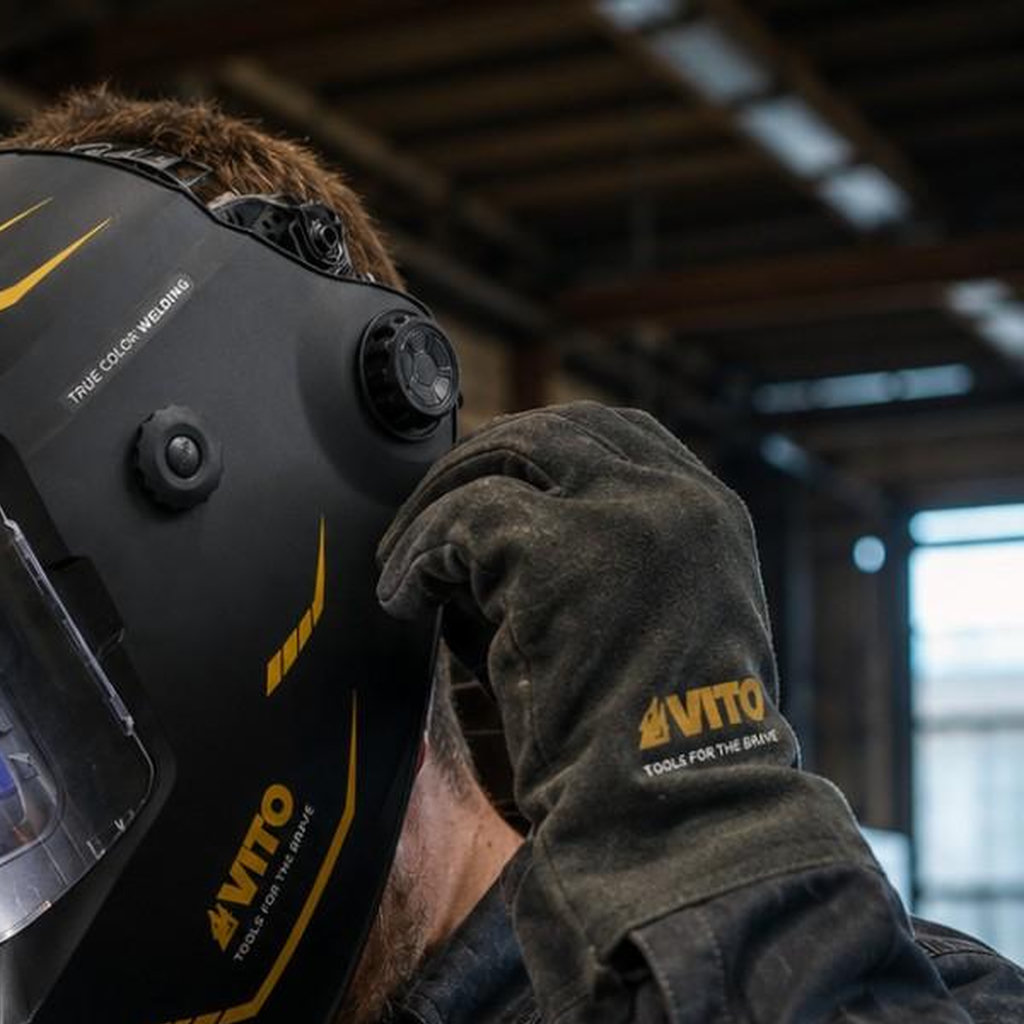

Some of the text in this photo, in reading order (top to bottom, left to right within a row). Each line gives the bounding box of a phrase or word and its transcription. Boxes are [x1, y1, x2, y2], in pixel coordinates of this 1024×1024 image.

[67, 278, 190, 404] TRUE COLOR WELDING
[665, 677, 765, 738] VITO
[643, 754, 687, 777] TOOLS
[688, 746, 716, 765] FOR
[716, 739, 741, 757] THE
[216, 783, 295, 906] VITO
[233, 915, 265, 962] TOOLS
[260, 885, 280, 914] FOR
